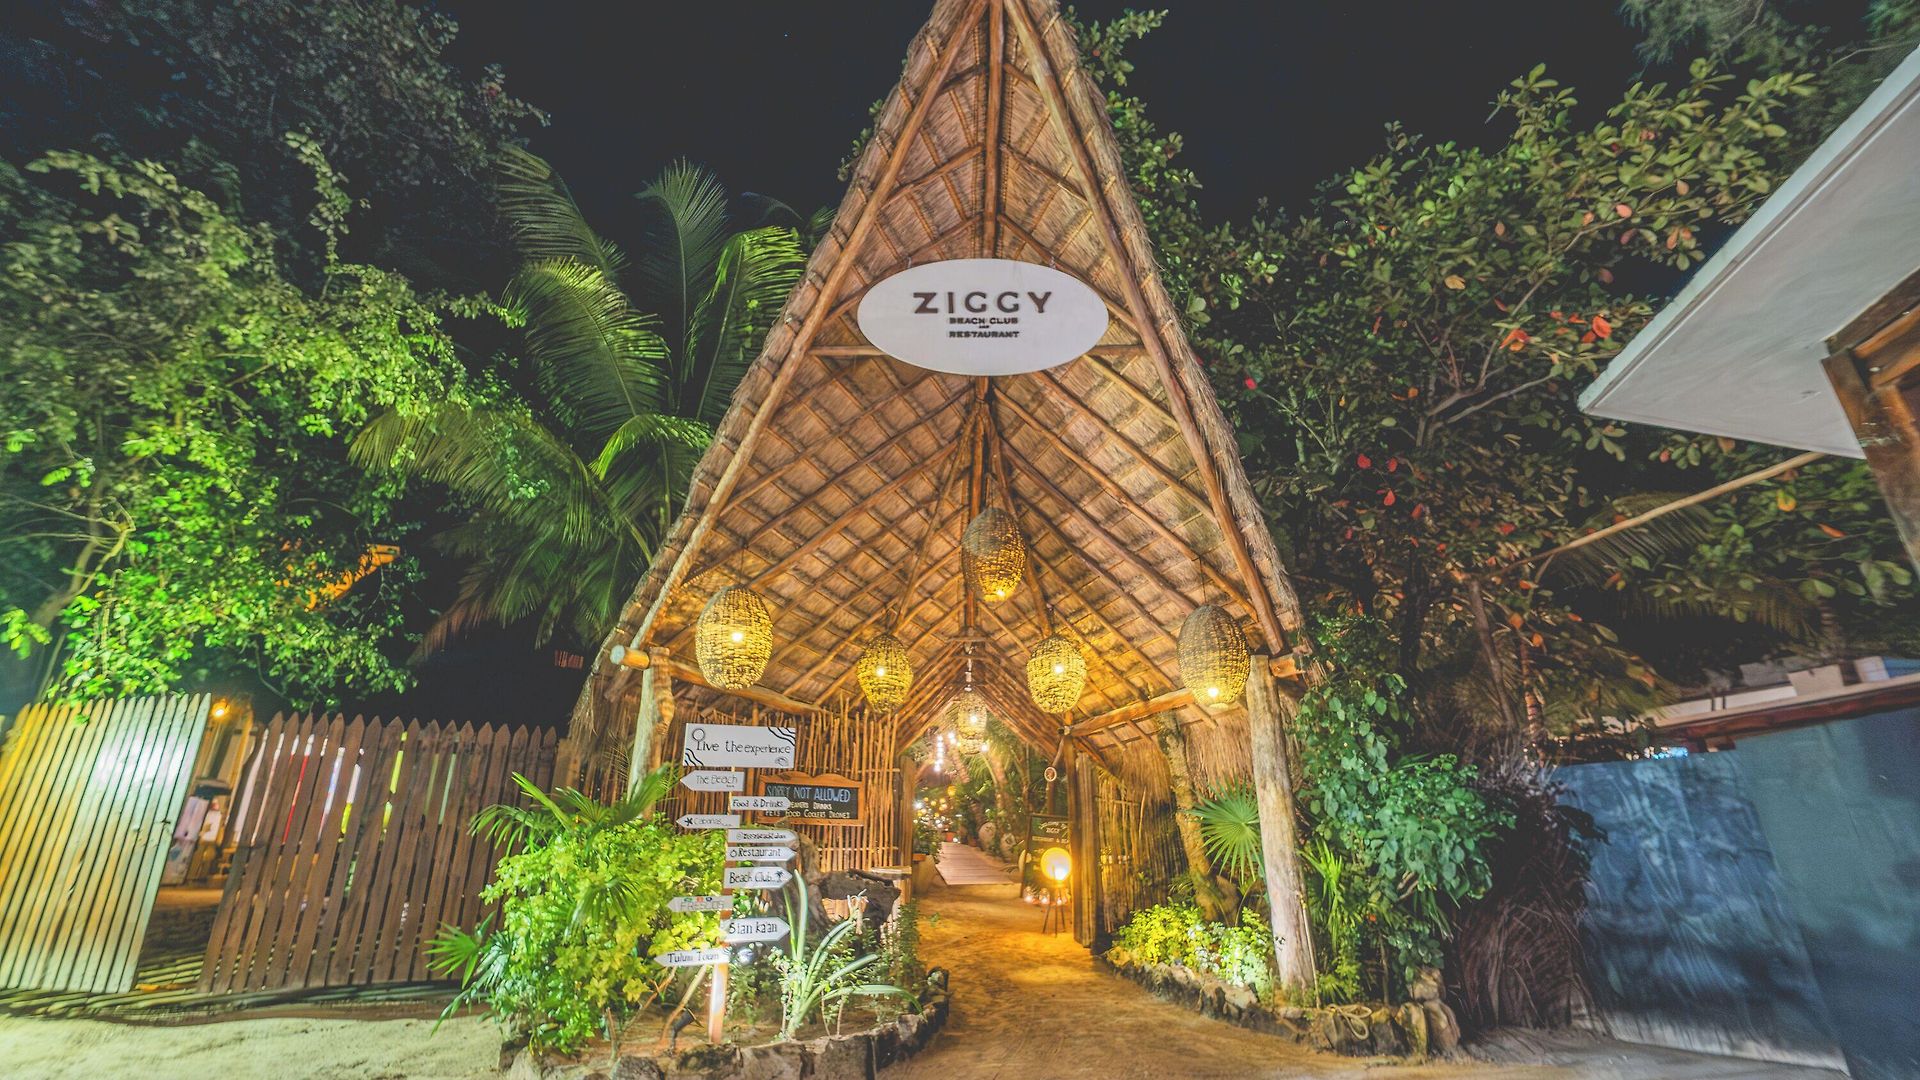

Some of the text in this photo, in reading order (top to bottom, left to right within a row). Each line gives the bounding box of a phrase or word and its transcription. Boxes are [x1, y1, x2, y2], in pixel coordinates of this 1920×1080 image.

[913, 291, 1052, 314] ZIGGY
[725, 740, 743, 753] the
[744, 744, 791, 755] experience
[696, 774, 738, 785] The Beach
[793, 787, 811, 799] NOT
[814, 788, 851, 802] ALLOWED
[732, 798, 783, 807] Food & Drinks
[738, 847, 781, 857] Restaurant
[730, 871, 772, 883] Beach Club
[729, 922, 752, 934] Sian
[667, 952, 693, 963] Tulum
